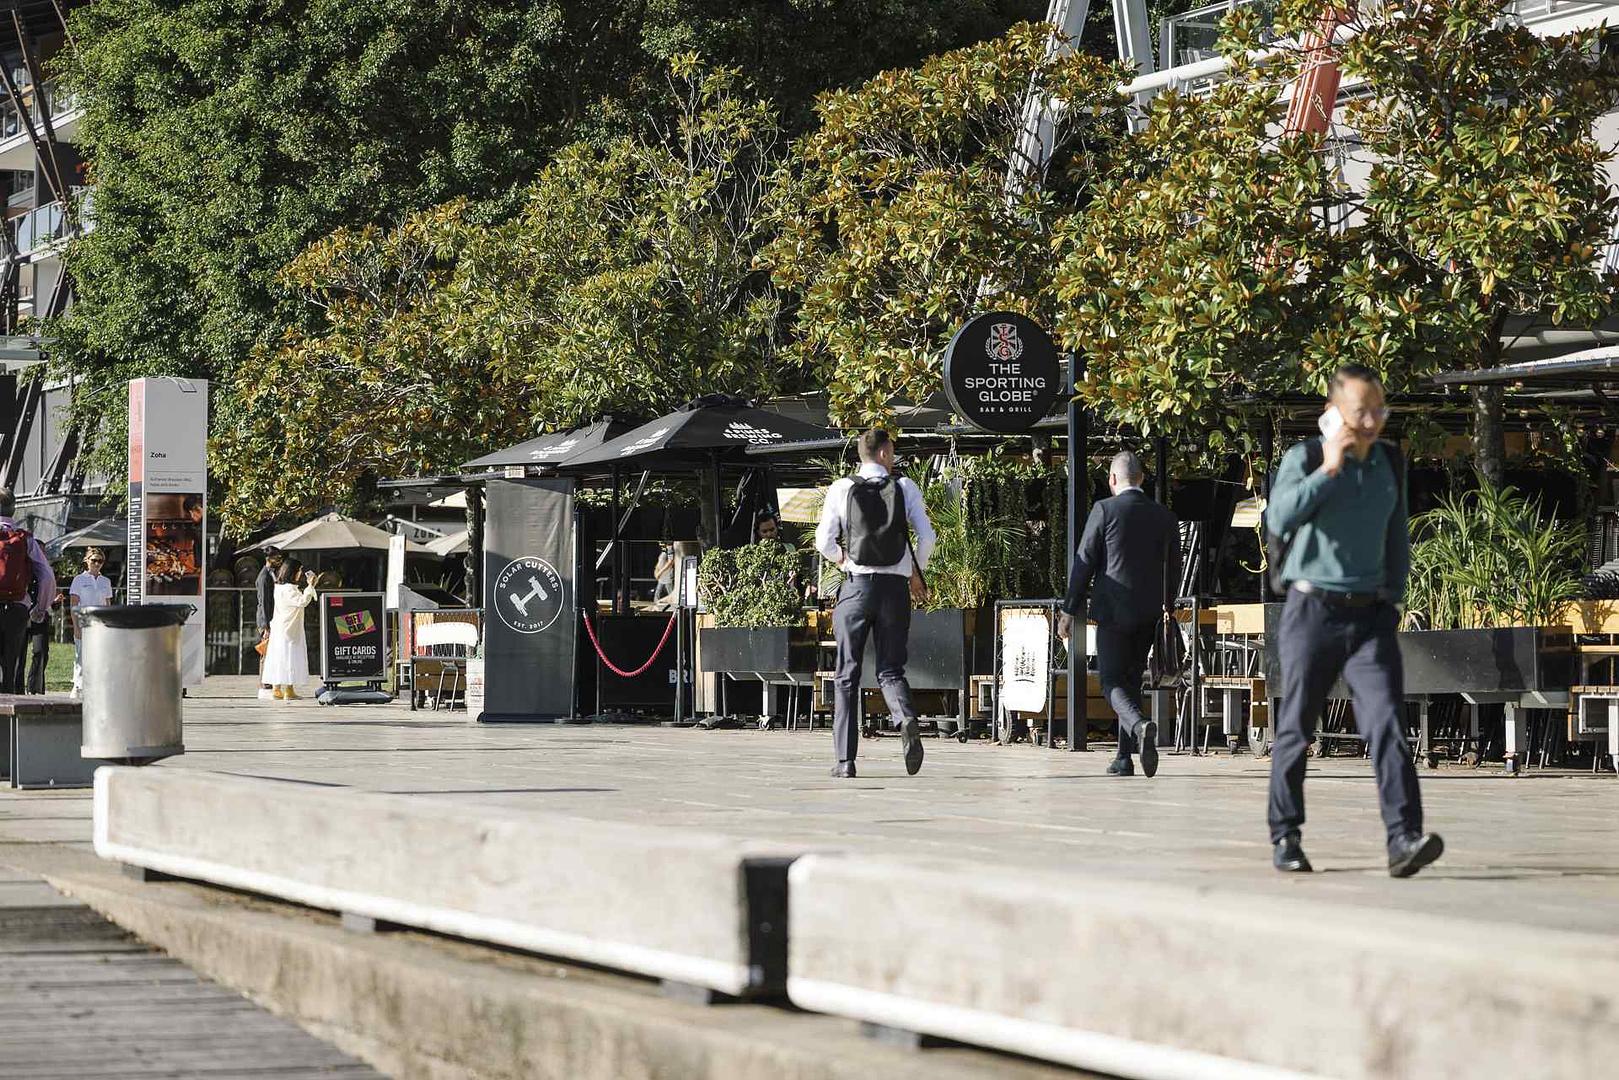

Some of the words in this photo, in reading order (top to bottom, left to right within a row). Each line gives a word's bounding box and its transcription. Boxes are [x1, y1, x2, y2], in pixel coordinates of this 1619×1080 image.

[989, 363, 1021, 375] THE
[964, 377, 1046, 389] SPORTING
[499, 563, 523, 589] SOLAR
[334, 646, 351, 655] GIFT
[352, 646, 376, 655] CARDS
